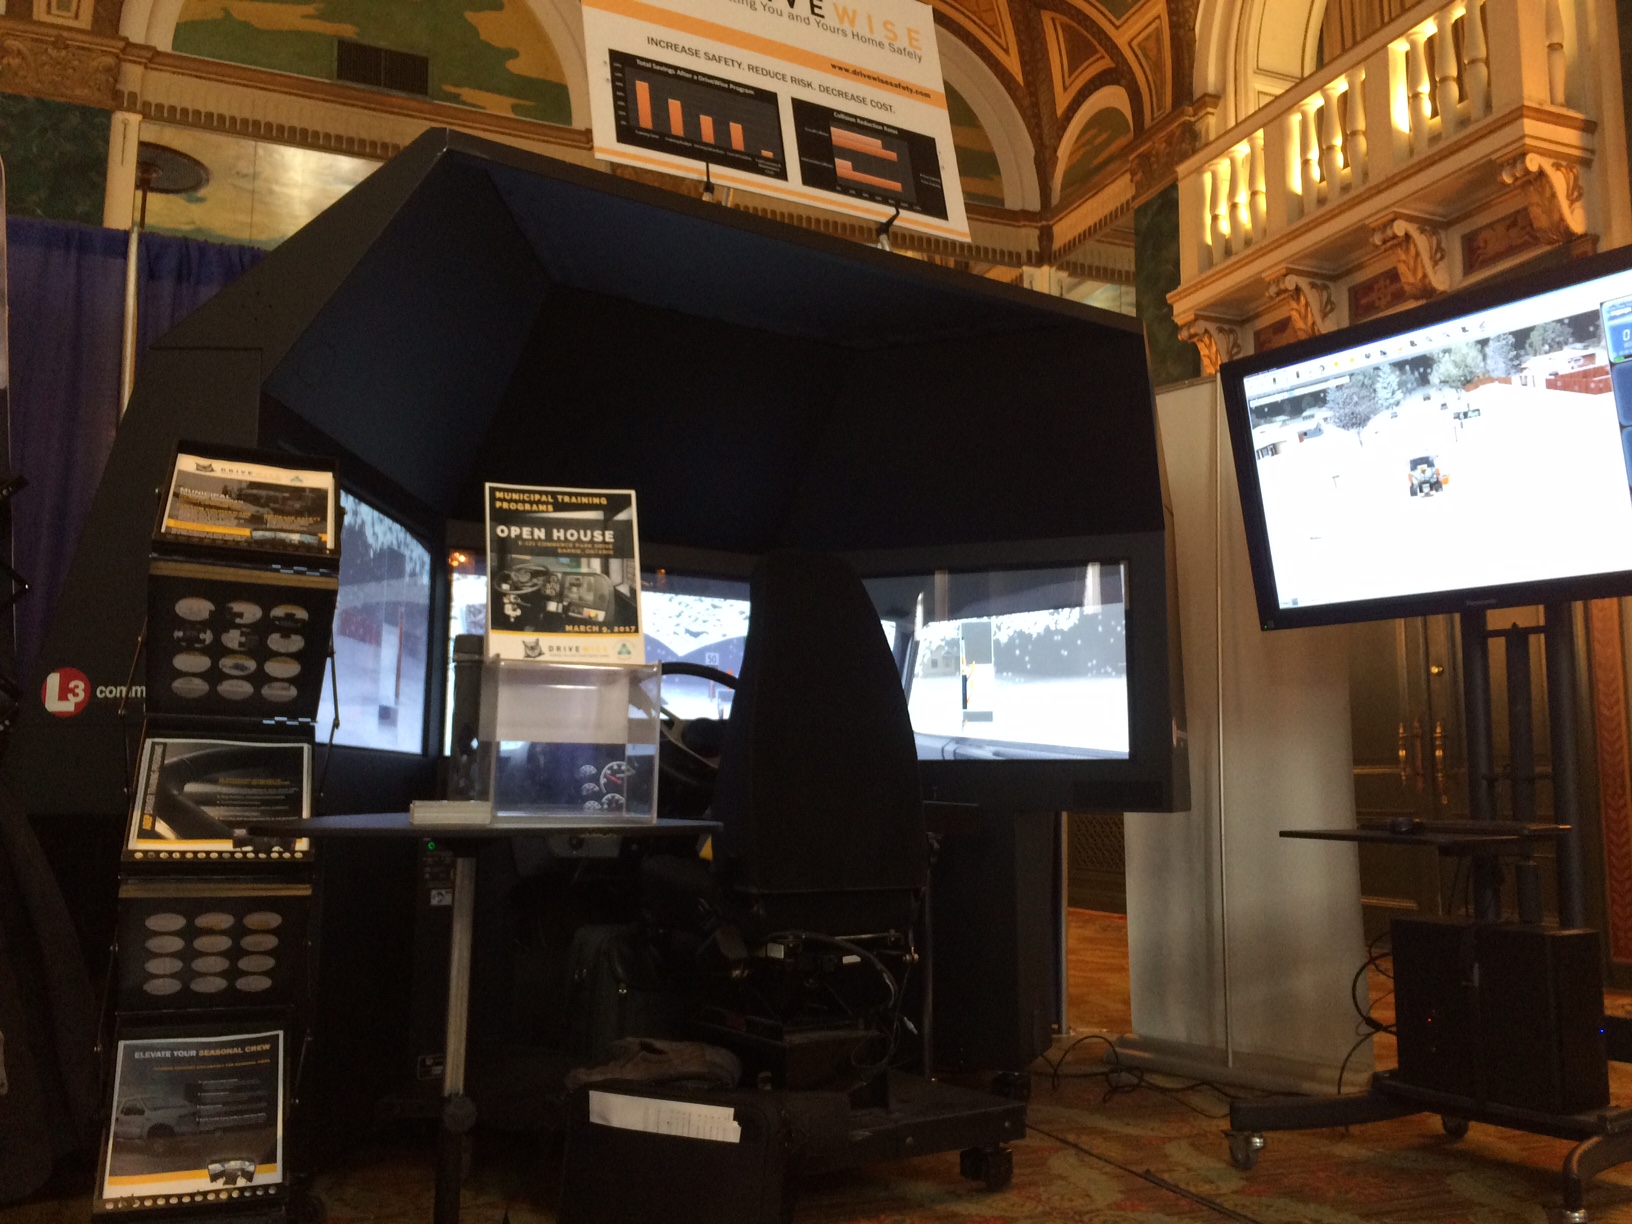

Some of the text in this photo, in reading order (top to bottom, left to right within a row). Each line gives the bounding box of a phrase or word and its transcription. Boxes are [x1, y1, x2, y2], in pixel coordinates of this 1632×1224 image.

[760, 1, 783, 17] You
[788, 11, 811, 26] and
[814, 18, 848, 38] Yours
[851, 30, 885, 50] Home
[888, 42, 923, 64] Safely
[647, 36, 896, 114] INCREASE SAFETY. REDUCE RISK. DECREASE COST.
[830, 63, 931, 99] www.drivewisesafety.com
[495, 491, 607, 505] MUNICIPAL TRAINING
[495, 501, 554, 512] PROGRAMS
[496, 525, 615, 543] OPEN HOUSE
[45, 672, 85, 712] L3
[134, 1050, 171, 1059] ELEVATE
[199, 1047, 243, 1057] SEASONAL
[244, 1043, 271, 1053] CREW
